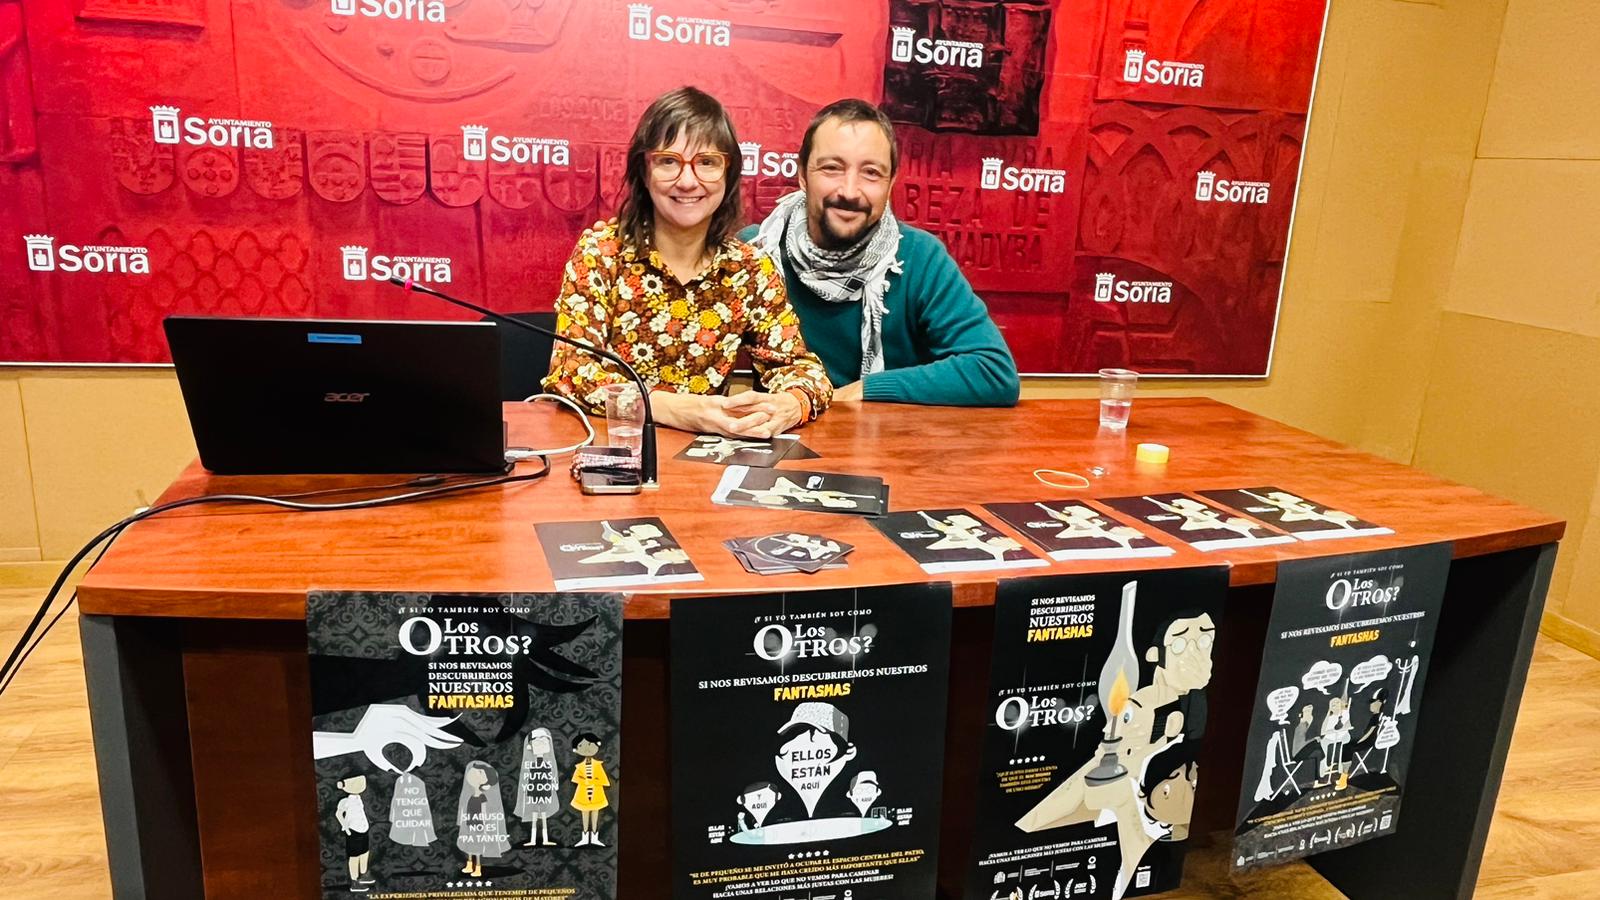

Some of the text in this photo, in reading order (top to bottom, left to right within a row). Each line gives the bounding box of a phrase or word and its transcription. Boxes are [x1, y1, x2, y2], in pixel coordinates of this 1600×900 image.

[655, 15, 730, 46] Soria
[915, 38, 983, 68] Soria
[1144, 59, 1204, 87] Soria
[208, 118, 272, 128] AYUNTAMIENTO
[184, 117, 273, 149] Soria
[512, 137, 568, 146] AYUNTAMIENTO
[491, 136, 569, 165] Soria
[1002, 167, 1065, 193] Soria
[1215, 179, 1269, 204] Soria
[82, 246, 148, 254] AYUNTAMIENTO
[59, 245, 149, 274] Soria
[393, 256, 451, 264] AYUNTAMIENTO
[371, 255, 451, 282] Soria
[1114, 280, 1171, 303] Soria
[1031, 594, 1096, 606] SI NOS REVISAMOS
[790, 611, 827, 620] TAMBIÉN
[1030, 603, 1095, 616] DESCUBRIREMOS
[1029, 612, 1094, 628] NUESTROS
[1027, 624, 1094, 643] FANTASMAS
[1330, 629, 1380, 648] FANTASMAS
[428, 662, 513, 670] SI NOS REVISAMOS
[428, 672, 513, 680] DESCUBRIREMOS
[698, 664, 928, 689] SI NOS REVISAMOS DESCUBRIREMOS NUESTROS
[428, 682, 514, 694] NUESTROS
[774, 682, 851, 701] FANTASMAS
[1028, 684, 1060, 693] TAMBIÉN
[1076, 680, 1097, 688] COMO
[428, 694, 514, 710] FANTASMAS
[791, 748, 831, 762] ELLOS
[524, 761, 553, 769] ELLAS
[791, 763, 831, 779] ESTÁN
[404, 787, 420, 795] NO
[521, 783, 559, 792] YO DON
[395, 797, 428, 806] TENGO
[526, 797, 552, 805] JUAN
[402, 808, 423, 817] QUE
[462, 812, 504, 821] SI ABUSO
[395, 820, 431, 828] CUIDAR
[469, 823, 497, 832] NO ES
[795, 859, 822, 867] OCUPAR
[832, 856, 859, 864] ESPACIO
[860, 853, 890, 861] CENTRAL
[718, 874, 754, 883] PROBABLE
[754, 872, 769, 880] QUE
[841, 861, 883, 870] IMPORTANTE
[781, 877, 795, 885] QUE
[807, 873, 830, 881] VEMOS
[849, 869, 880, 878] CAMINAR
[713, 891, 735, 899] HACIA
[754, 885, 796, 894] RELACIONES
[811, 881, 834, 889] JUSTAS
